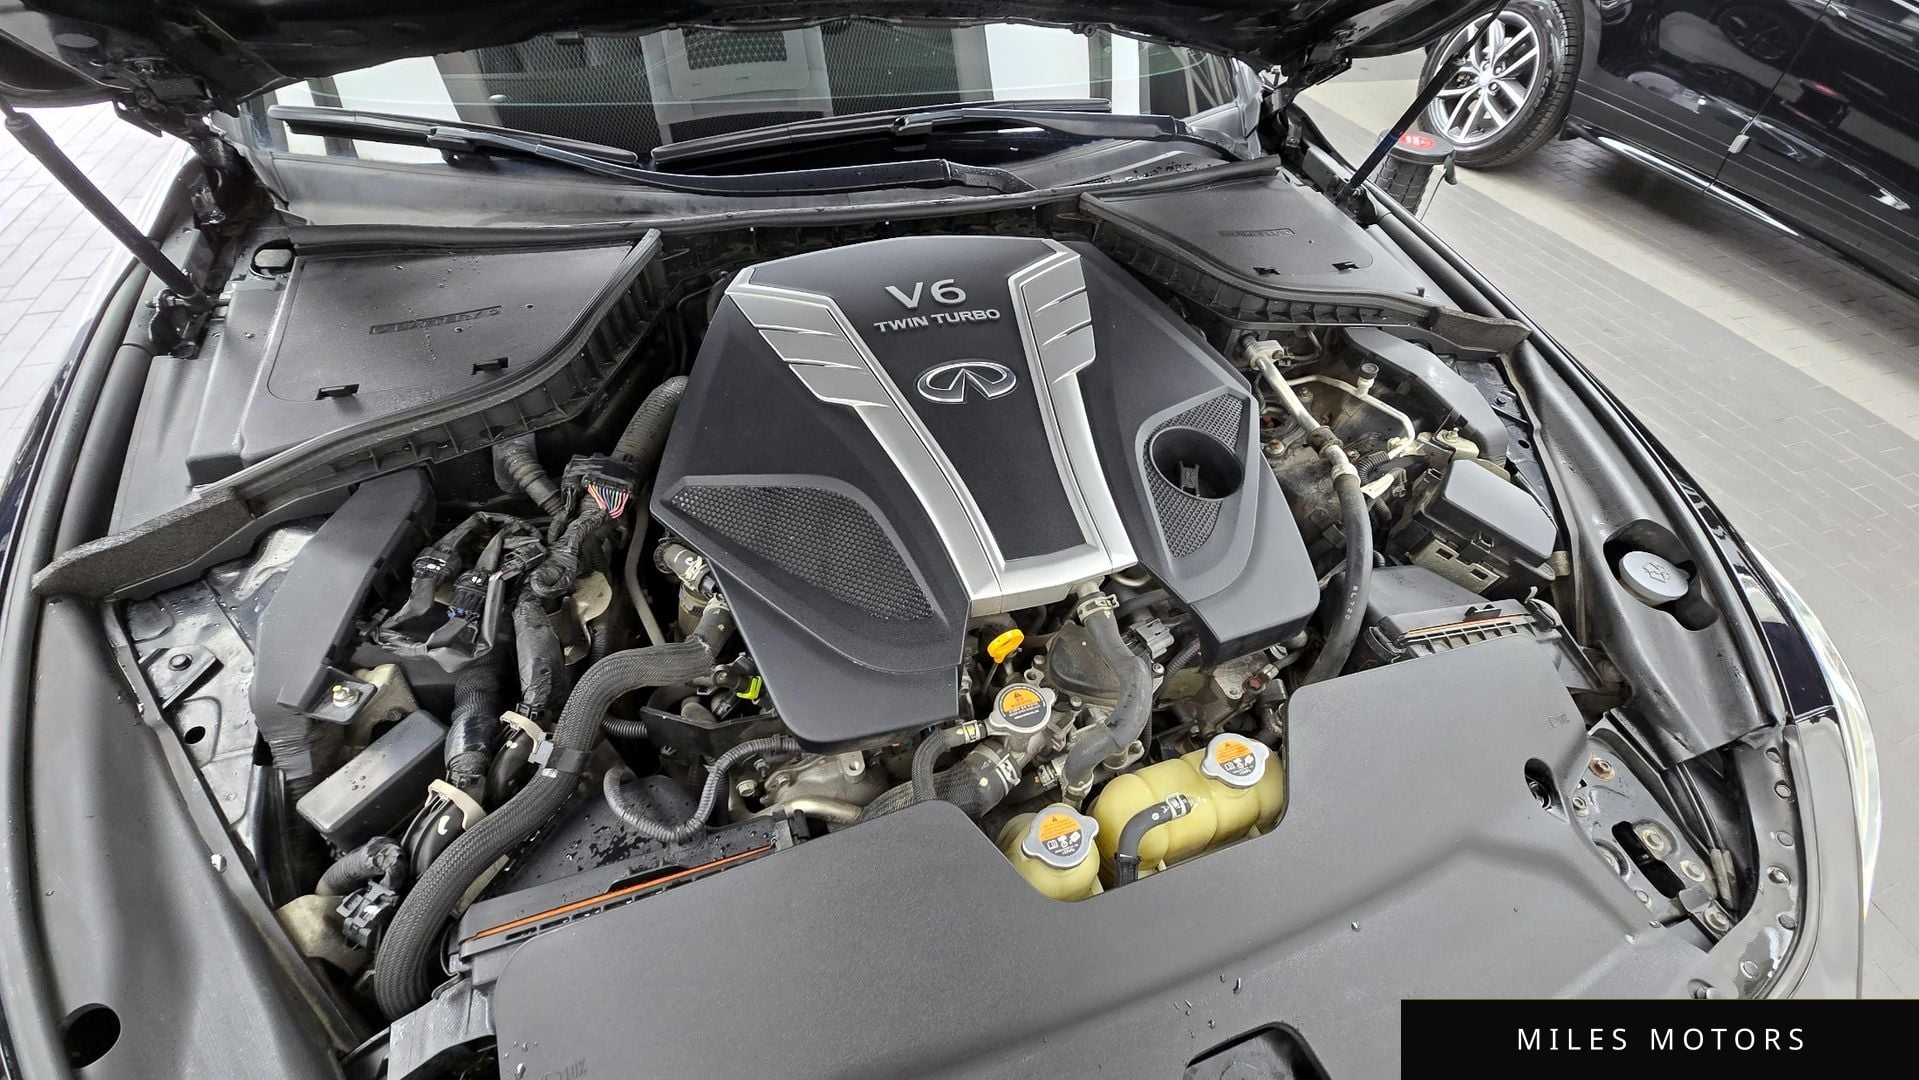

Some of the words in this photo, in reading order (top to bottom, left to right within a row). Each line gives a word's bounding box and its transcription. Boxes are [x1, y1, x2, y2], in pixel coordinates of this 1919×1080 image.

[885, 279, 966, 309] V6
[873, 315, 929, 333] TWIN
[931, 309, 1001, 324] TURBO
